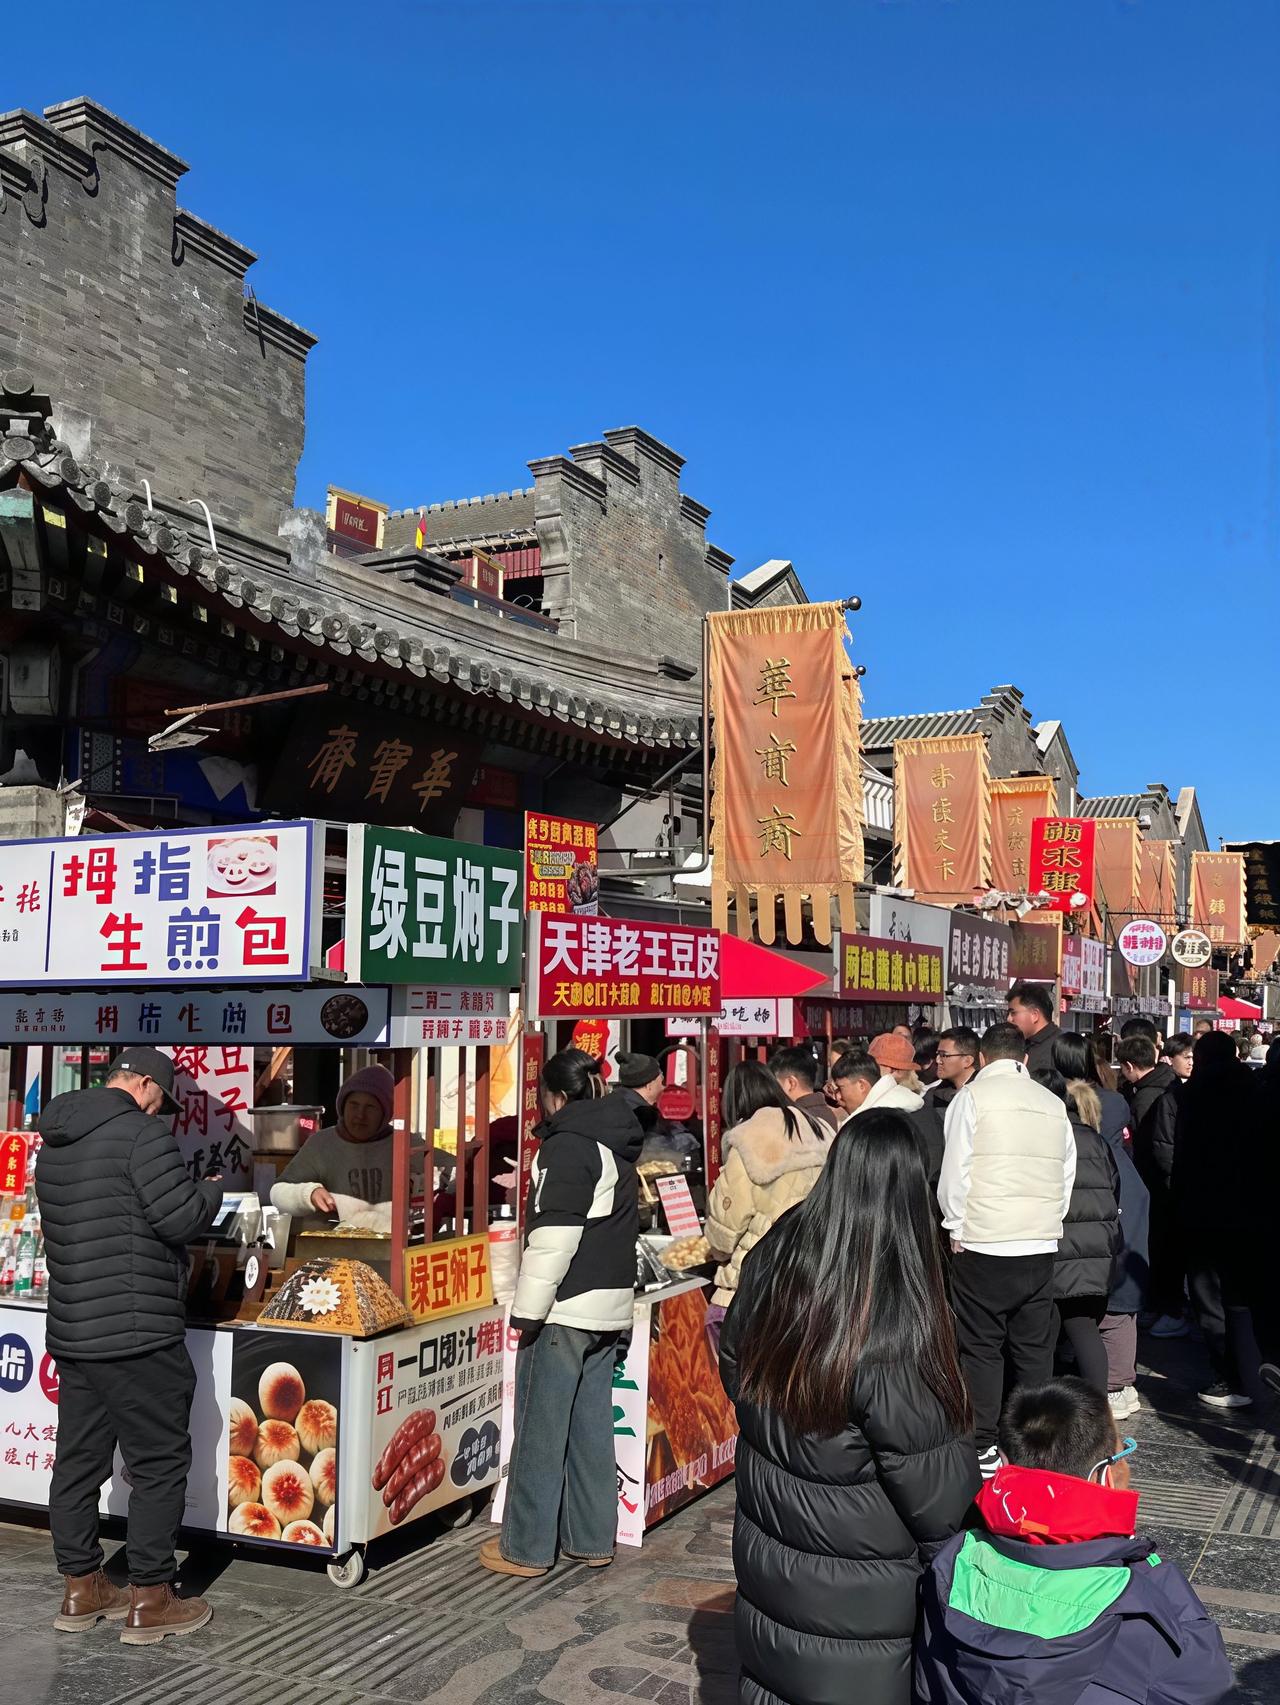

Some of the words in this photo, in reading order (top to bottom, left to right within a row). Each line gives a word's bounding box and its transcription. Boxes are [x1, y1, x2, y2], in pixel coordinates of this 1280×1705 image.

[369, 845, 520, 964] 绿豆焖子
[99, 905, 289, 971] 生煎包
[543, 921, 720, 980] 天津老王豆皮
